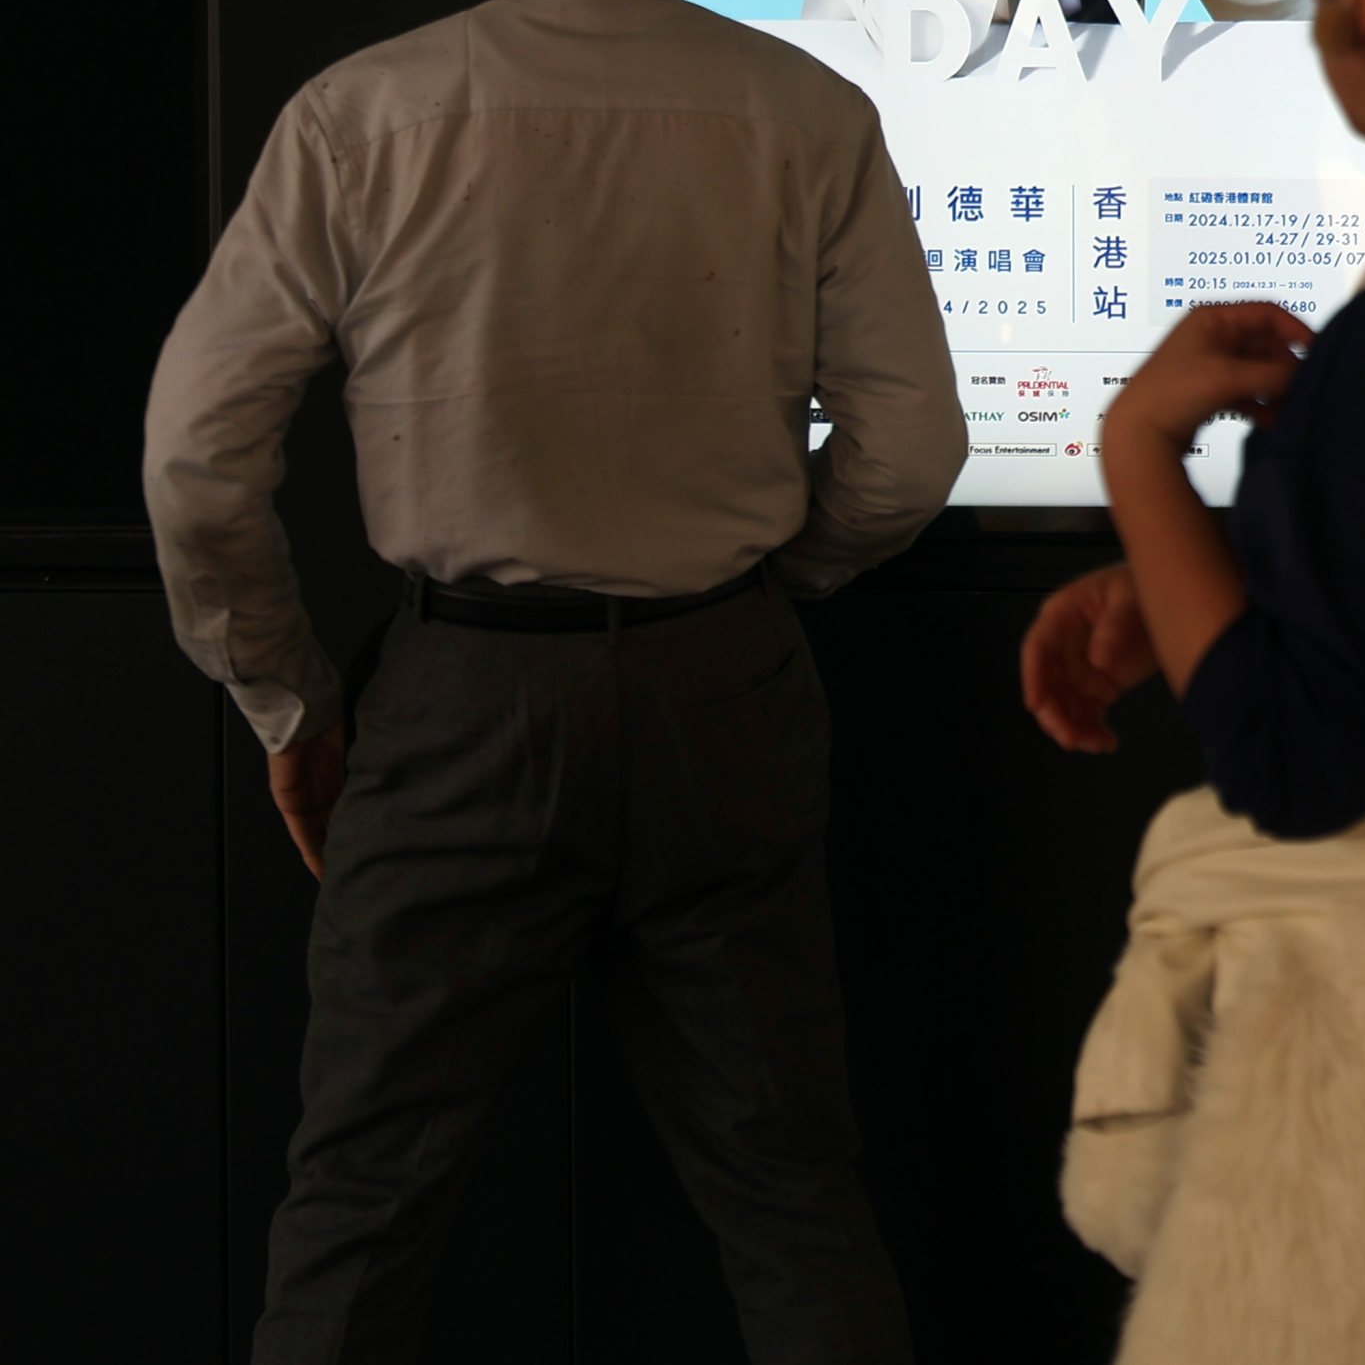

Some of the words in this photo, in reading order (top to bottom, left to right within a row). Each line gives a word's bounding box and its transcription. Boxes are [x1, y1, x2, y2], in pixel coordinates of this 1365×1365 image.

[1165, 213, 1183, 223] 日期
[1188, 213, 1298, 227] 2024.12.17-19
[1315, 214, 1360, 227] 21-22
[1315, 232, 1359, 246] 29-31
[1092, 185, 1128, 320] 香港站
[924, 248, 1046, 273] 迴演唱會
[1165, 277, 1184, 287] 時間
[1188, 277, 1227, 289] 20:15
[1017, 381, 1069, 390] PRUDENTIAL
[964, 412, 1005, 422] ATHAY
[1017, 411, 1058, 422] OSIM
[969, 446, 992, 455] Focus
[995, 446, 1050, 454] Entertainment
